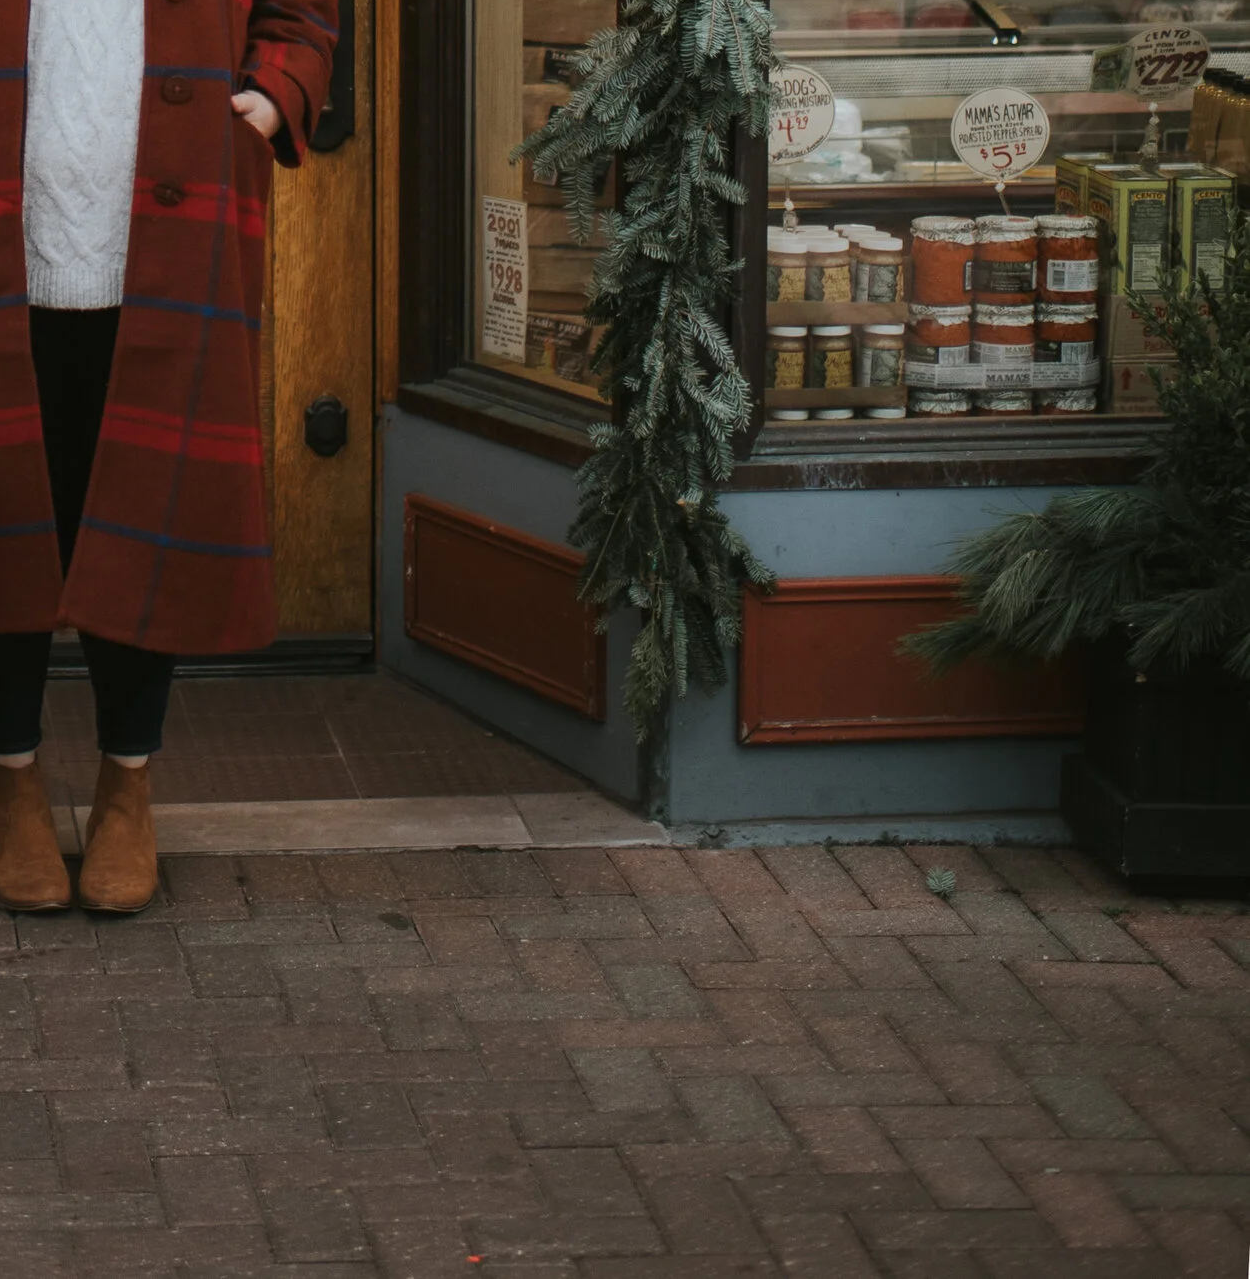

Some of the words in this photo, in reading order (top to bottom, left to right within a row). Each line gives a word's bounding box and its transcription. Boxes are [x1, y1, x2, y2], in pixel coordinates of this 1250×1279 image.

[1145, 29, 1191, 43] CENTO
[784, 78, 817, 96] DOGS
[798, 94, 831, 108] MUSTARD
[965, 104, 1001, 125] MAMA'S
[1003, 103, 1035, 122] AJVAR
[959, 131, 992, 145] ROASTED
[993, 127, 1018, 141] PEPPER
[1019, 125, 1043, 137] SPREAD
[1135, 192, 1163, 201] CENTO
[1199, 191, 1221, 199] CENT
[487, 213, 521, 239] 2001
[489, 263, 523, 294] 1998
[986, 374, 1031, 383] MAMA'S
